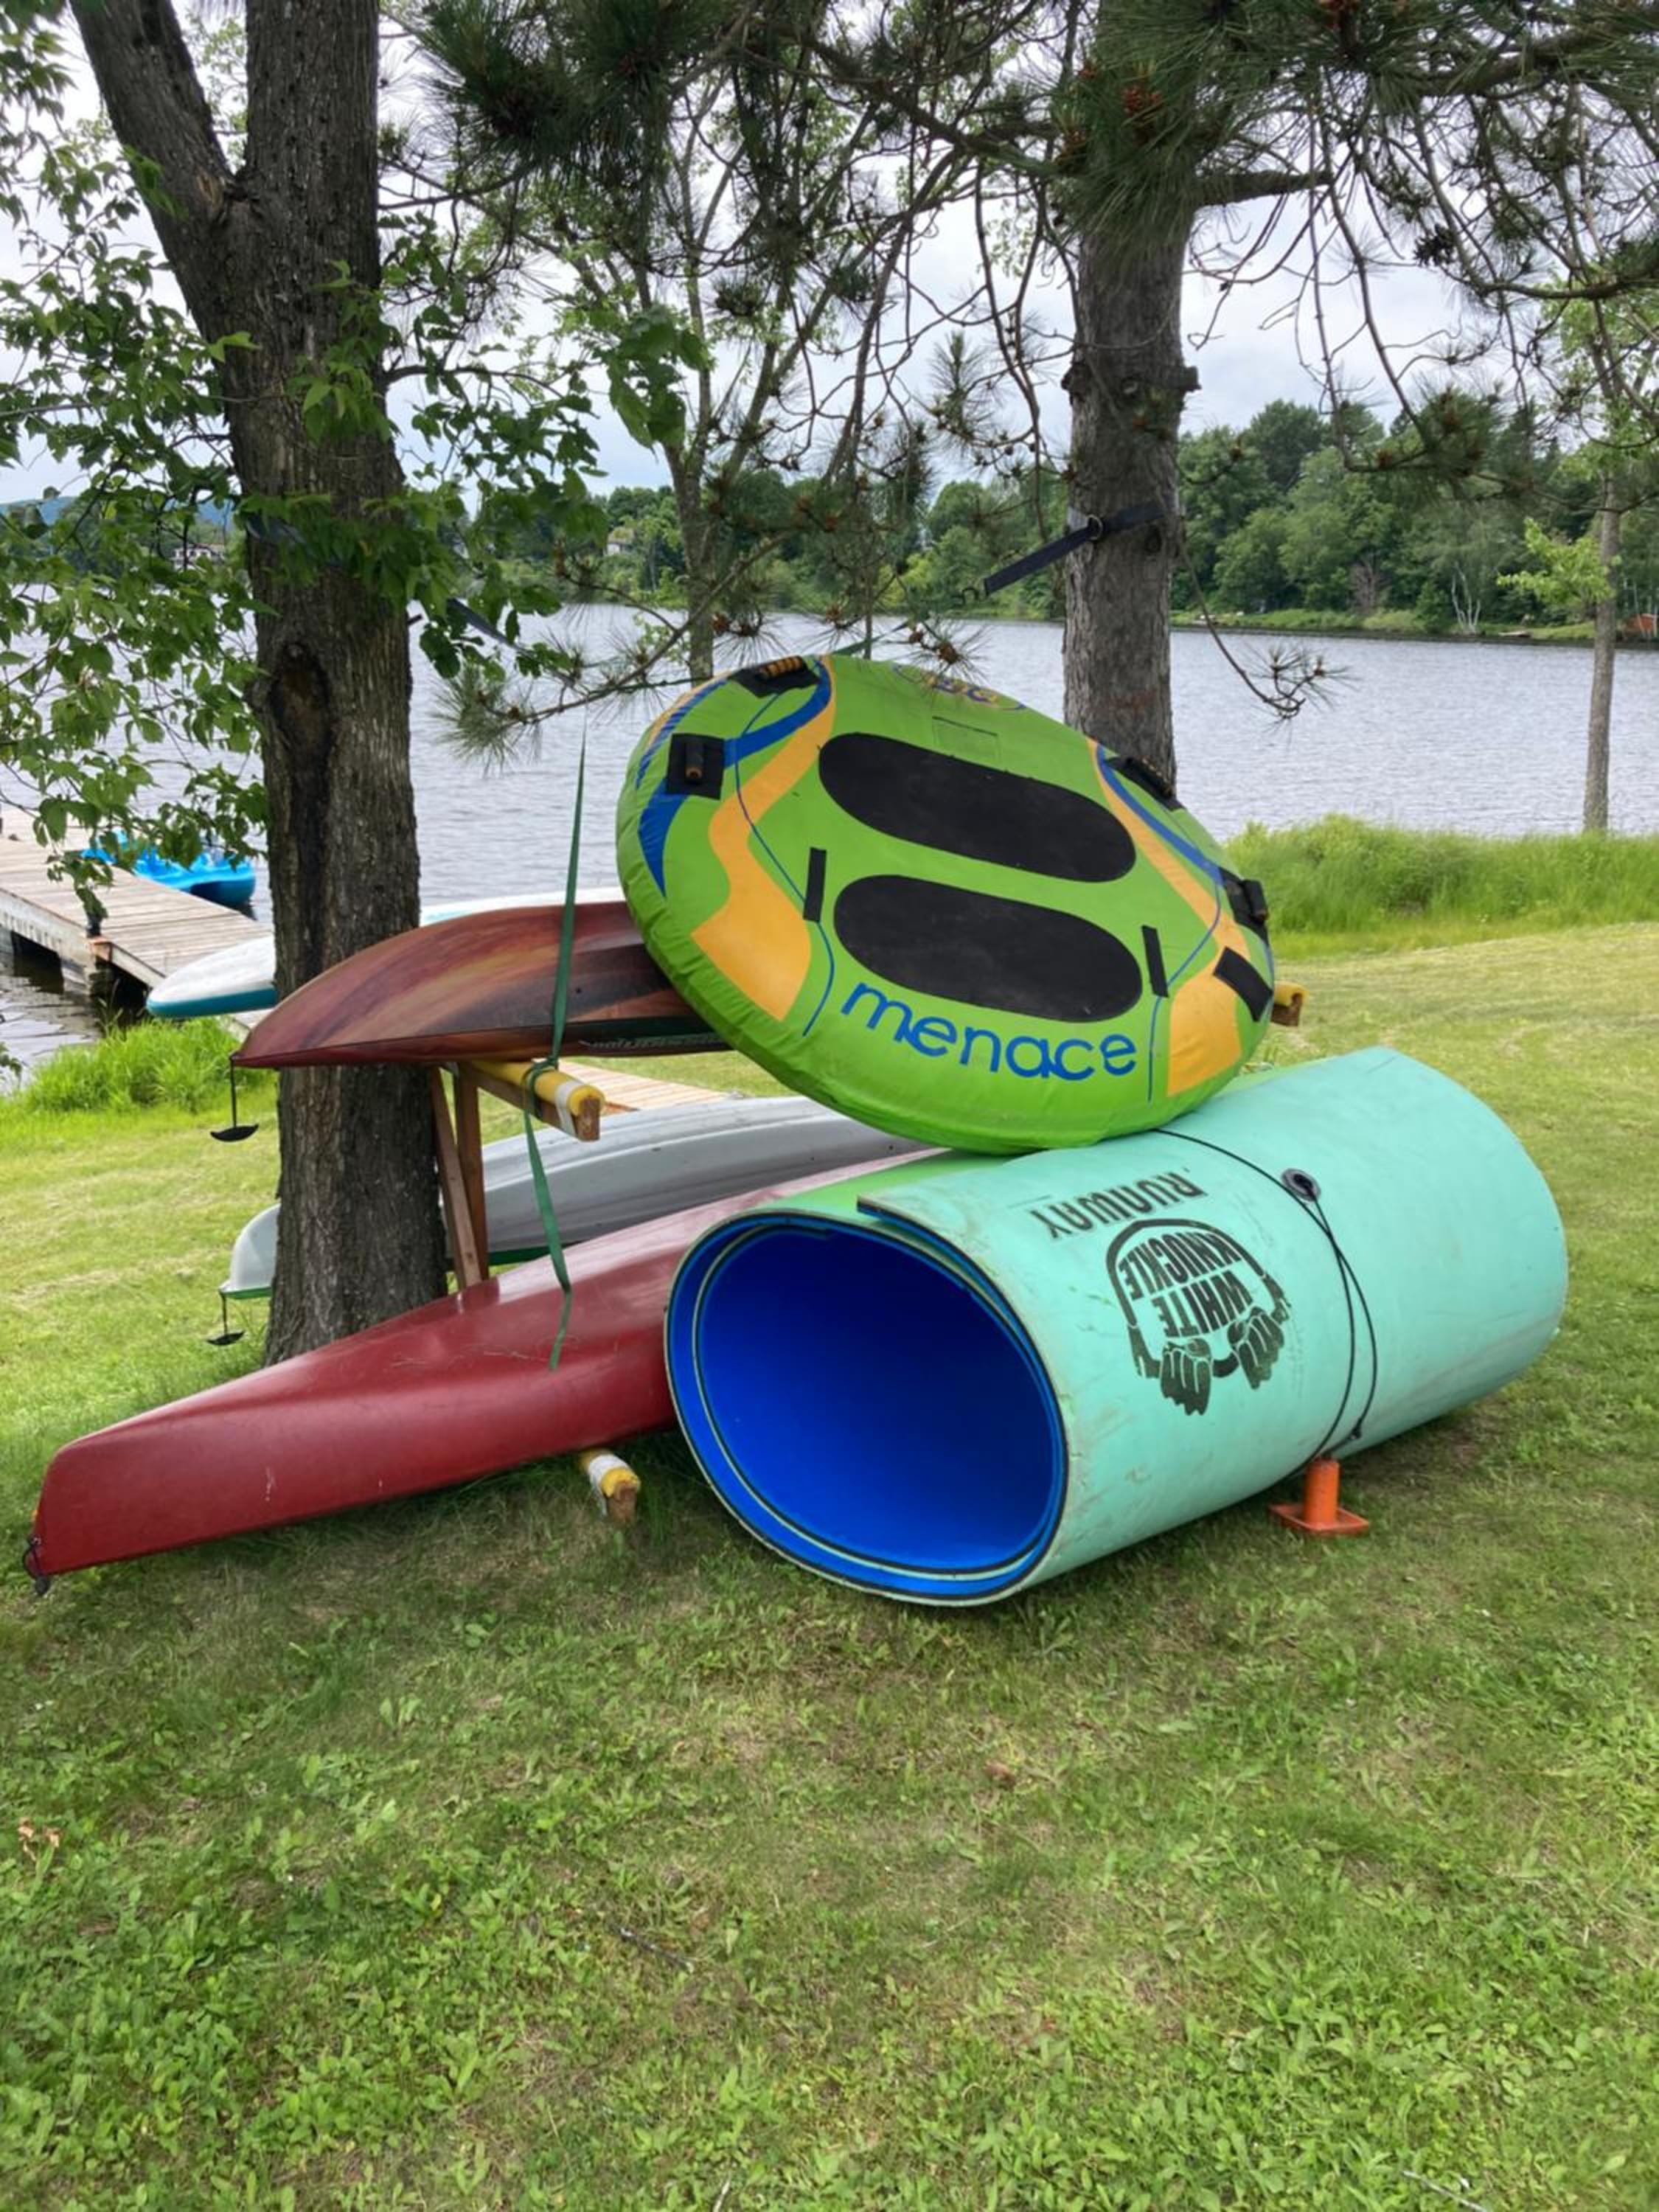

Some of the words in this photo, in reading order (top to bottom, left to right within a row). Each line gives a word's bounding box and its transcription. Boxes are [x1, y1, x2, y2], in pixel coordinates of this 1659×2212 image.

[841, 982, 1136, 1081] menace
[1029, 1171, 1207, 1238] RUNWAY
[1119, 1231, 1242, 1301] KNUCKLE
[1152, 1270, 1253, 1338] WHITE
